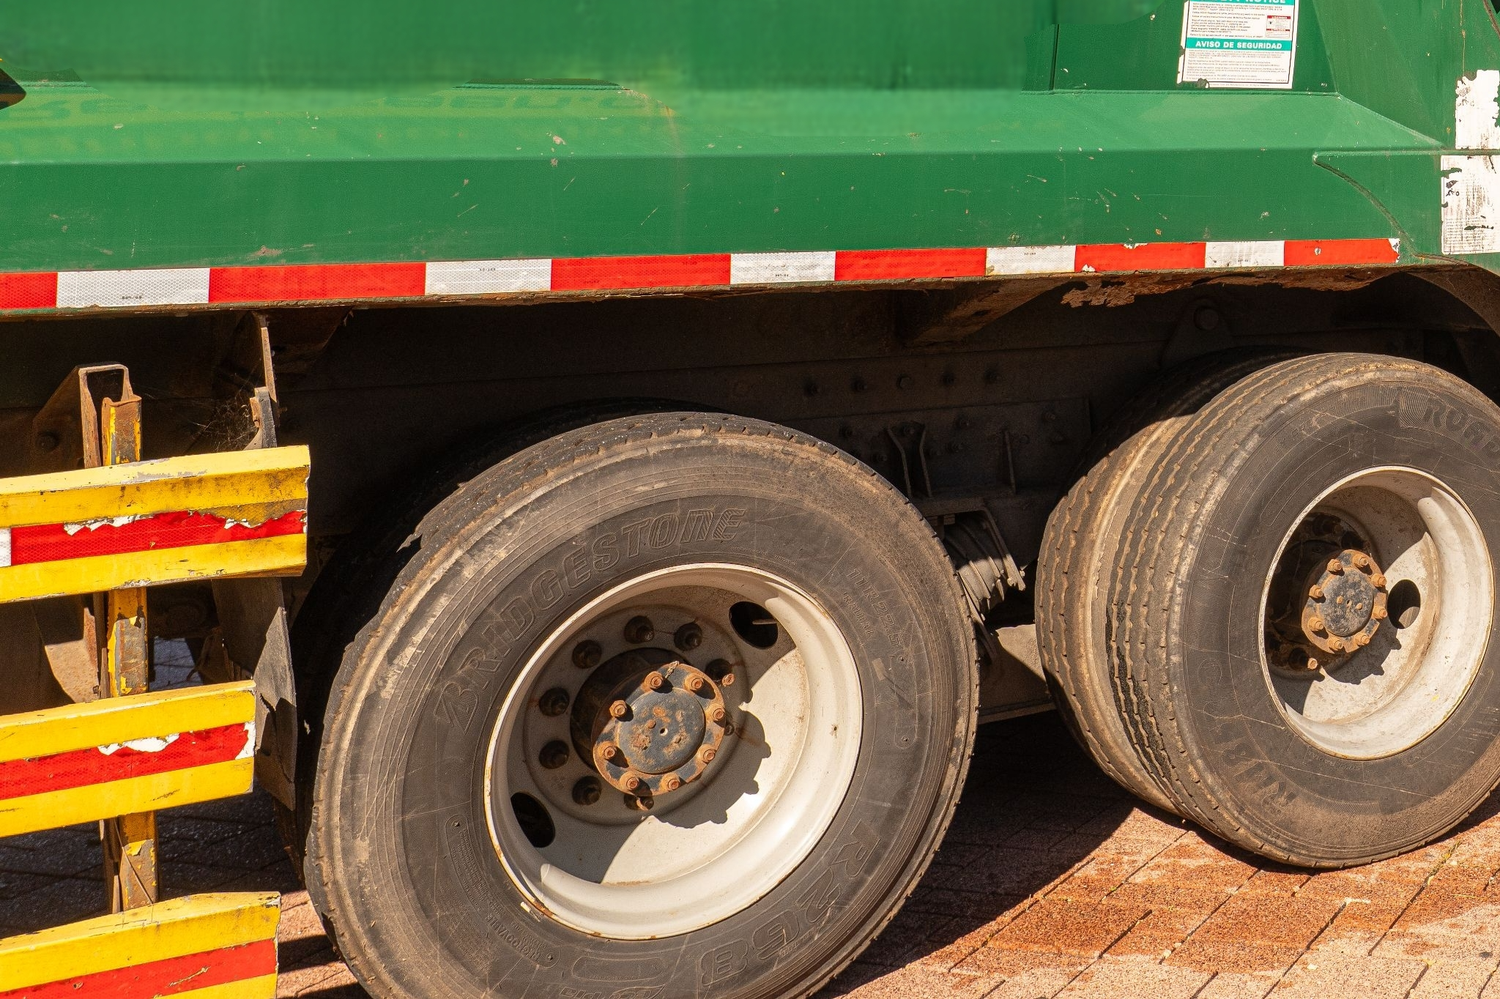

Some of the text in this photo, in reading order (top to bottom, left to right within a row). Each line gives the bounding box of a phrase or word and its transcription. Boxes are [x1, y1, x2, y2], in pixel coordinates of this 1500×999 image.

[1195, 40, 1282, 50] AVISO DE SEGURIDAD
[433, 507, 747, 734] BRIDGESTONE
[700, 819, 881, 986] R268
